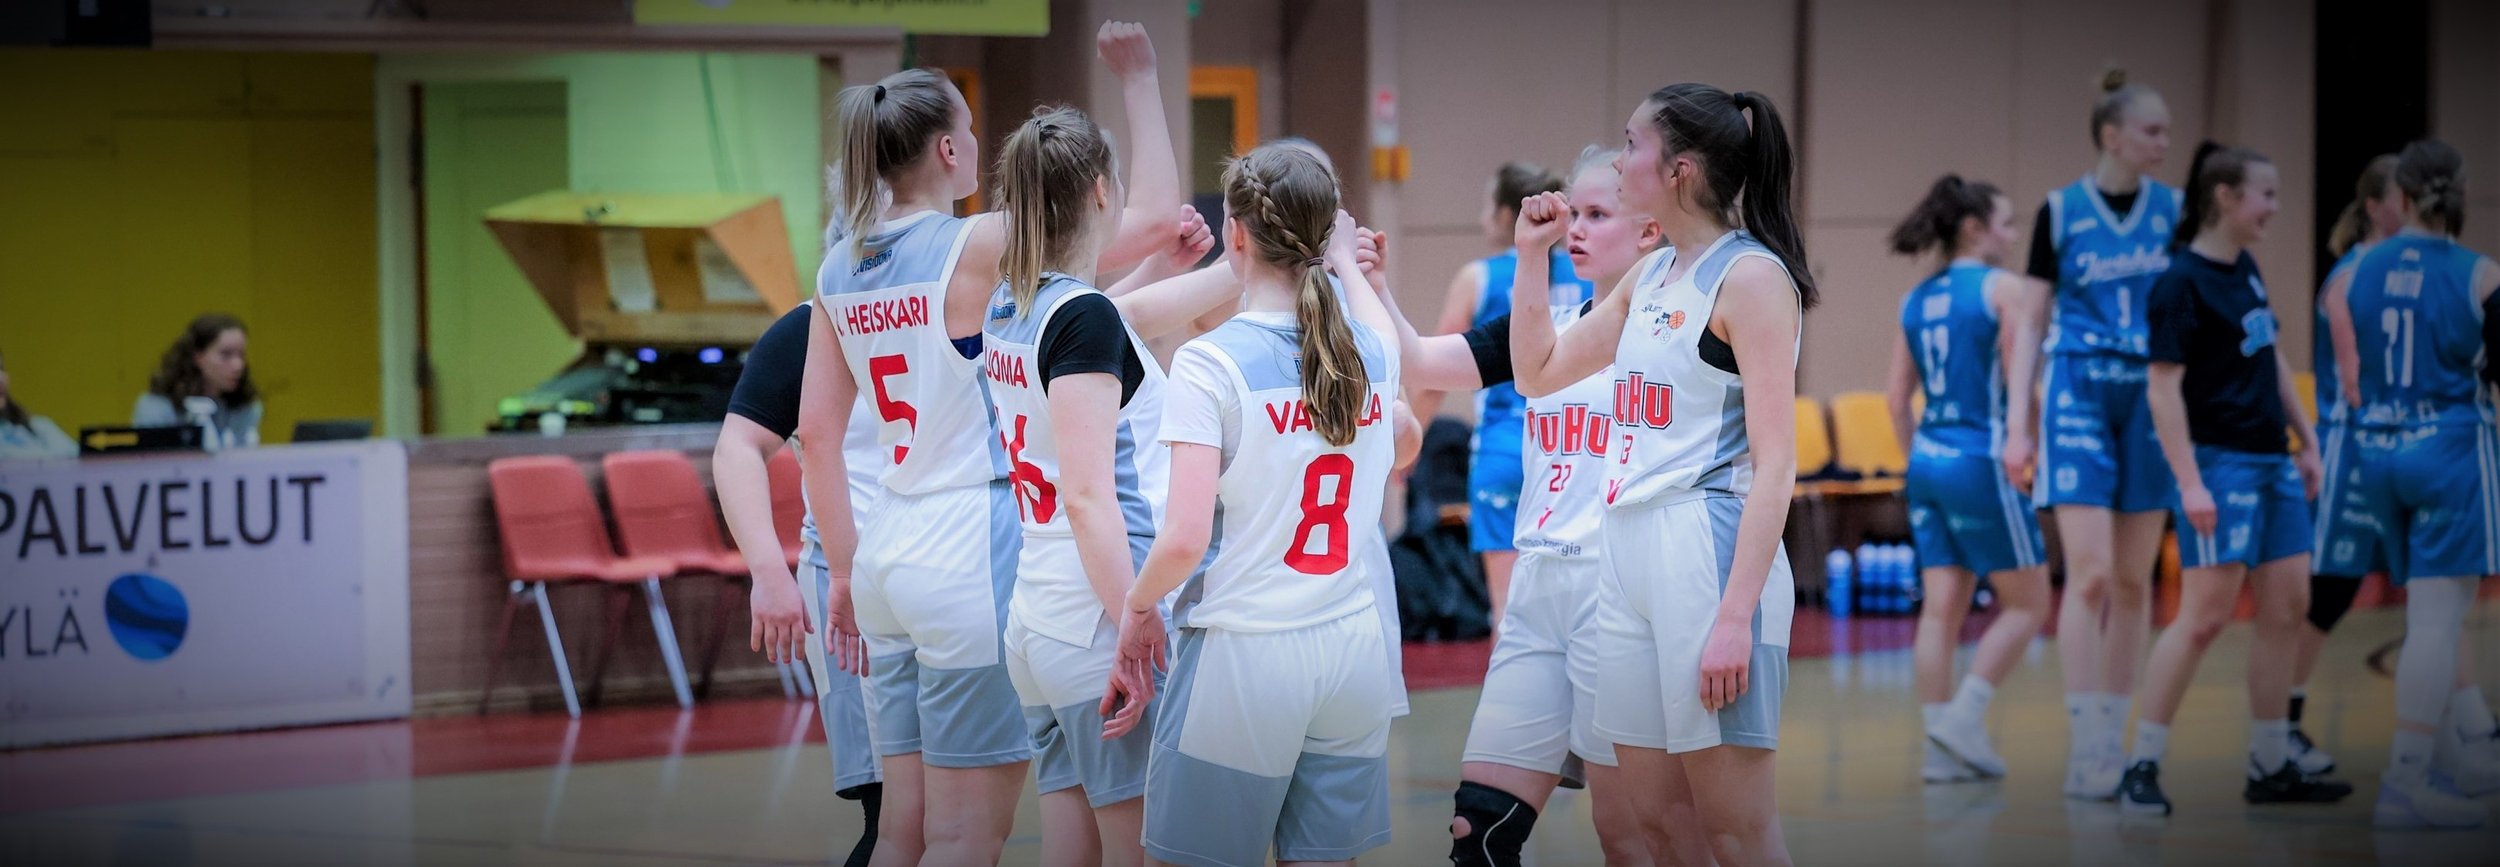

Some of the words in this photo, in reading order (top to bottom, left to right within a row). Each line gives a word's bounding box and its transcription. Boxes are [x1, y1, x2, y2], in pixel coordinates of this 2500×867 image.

[845, 295, 928, 336] HEISKARI
[869, 354, 917, 465] 5
[1284, 454, 1354, 574] 8
